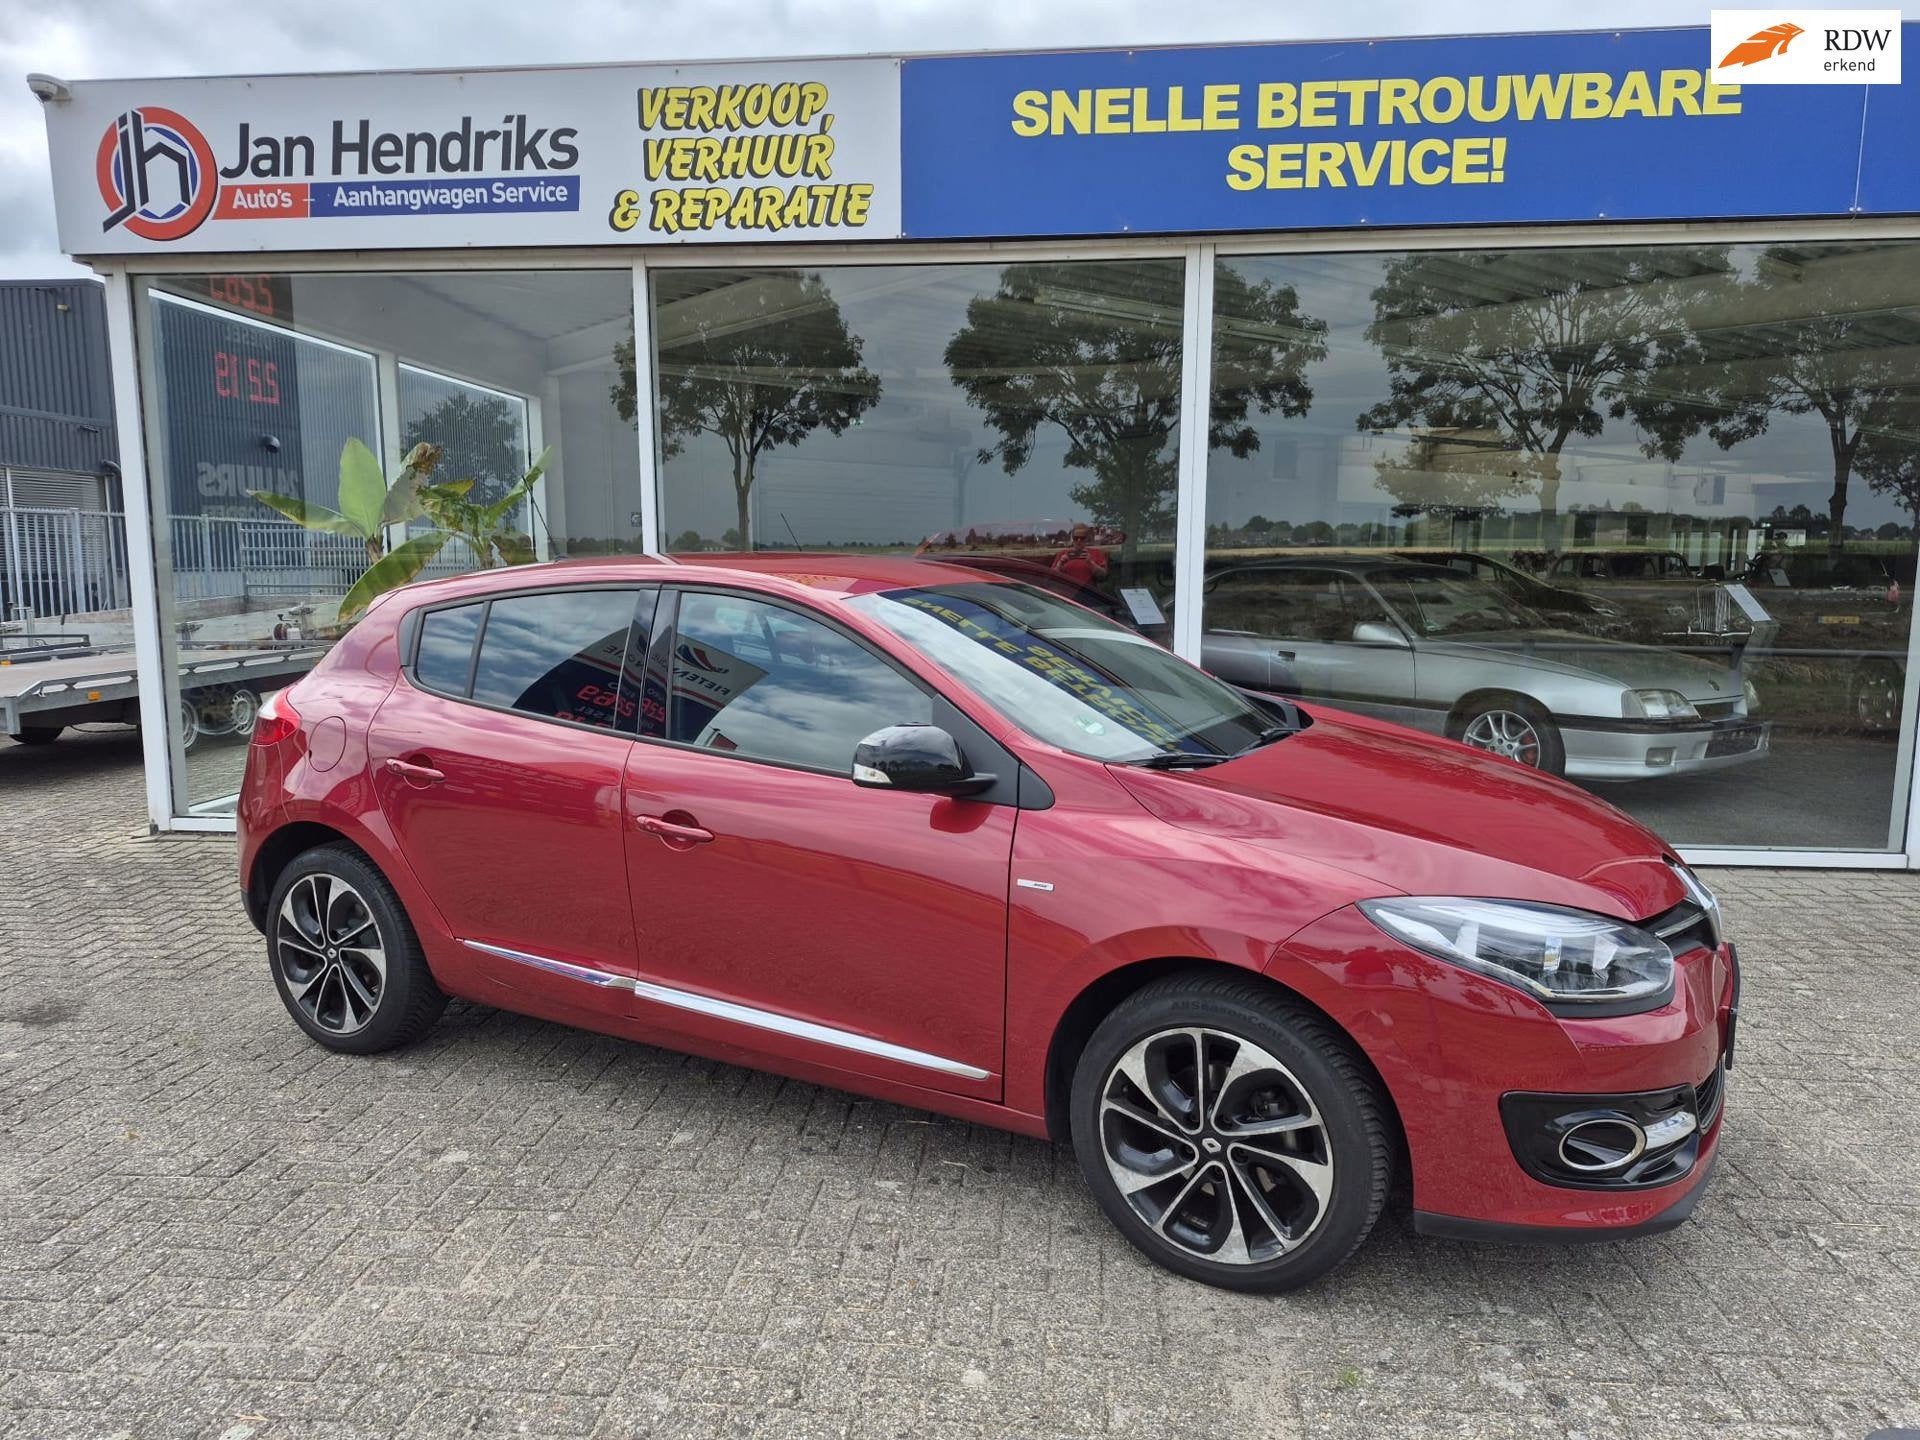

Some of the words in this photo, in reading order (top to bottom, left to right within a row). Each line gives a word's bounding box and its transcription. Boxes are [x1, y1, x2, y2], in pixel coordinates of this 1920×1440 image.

[638, 82, 835, 136] VERKOOP,
[1011, 84, 1240, 137] SNELLE
[1256, 68, 1743, 130] BETROUWBARE
[220, 122, 315, 179] Jan
[331, 114, 580, 176] Hendriks
[643, 134, 836, 182] VERHUUR
[1226, 136, 1508, 191] SERVICE!
[232, 189, 293, 210] Auto's
[333, 184, 488, 210] Aanhangwagen
[491, 181, 569, 204] Service
[609, 189, 641, 233] &
[649, 183, 875, 235] REPARATIE
